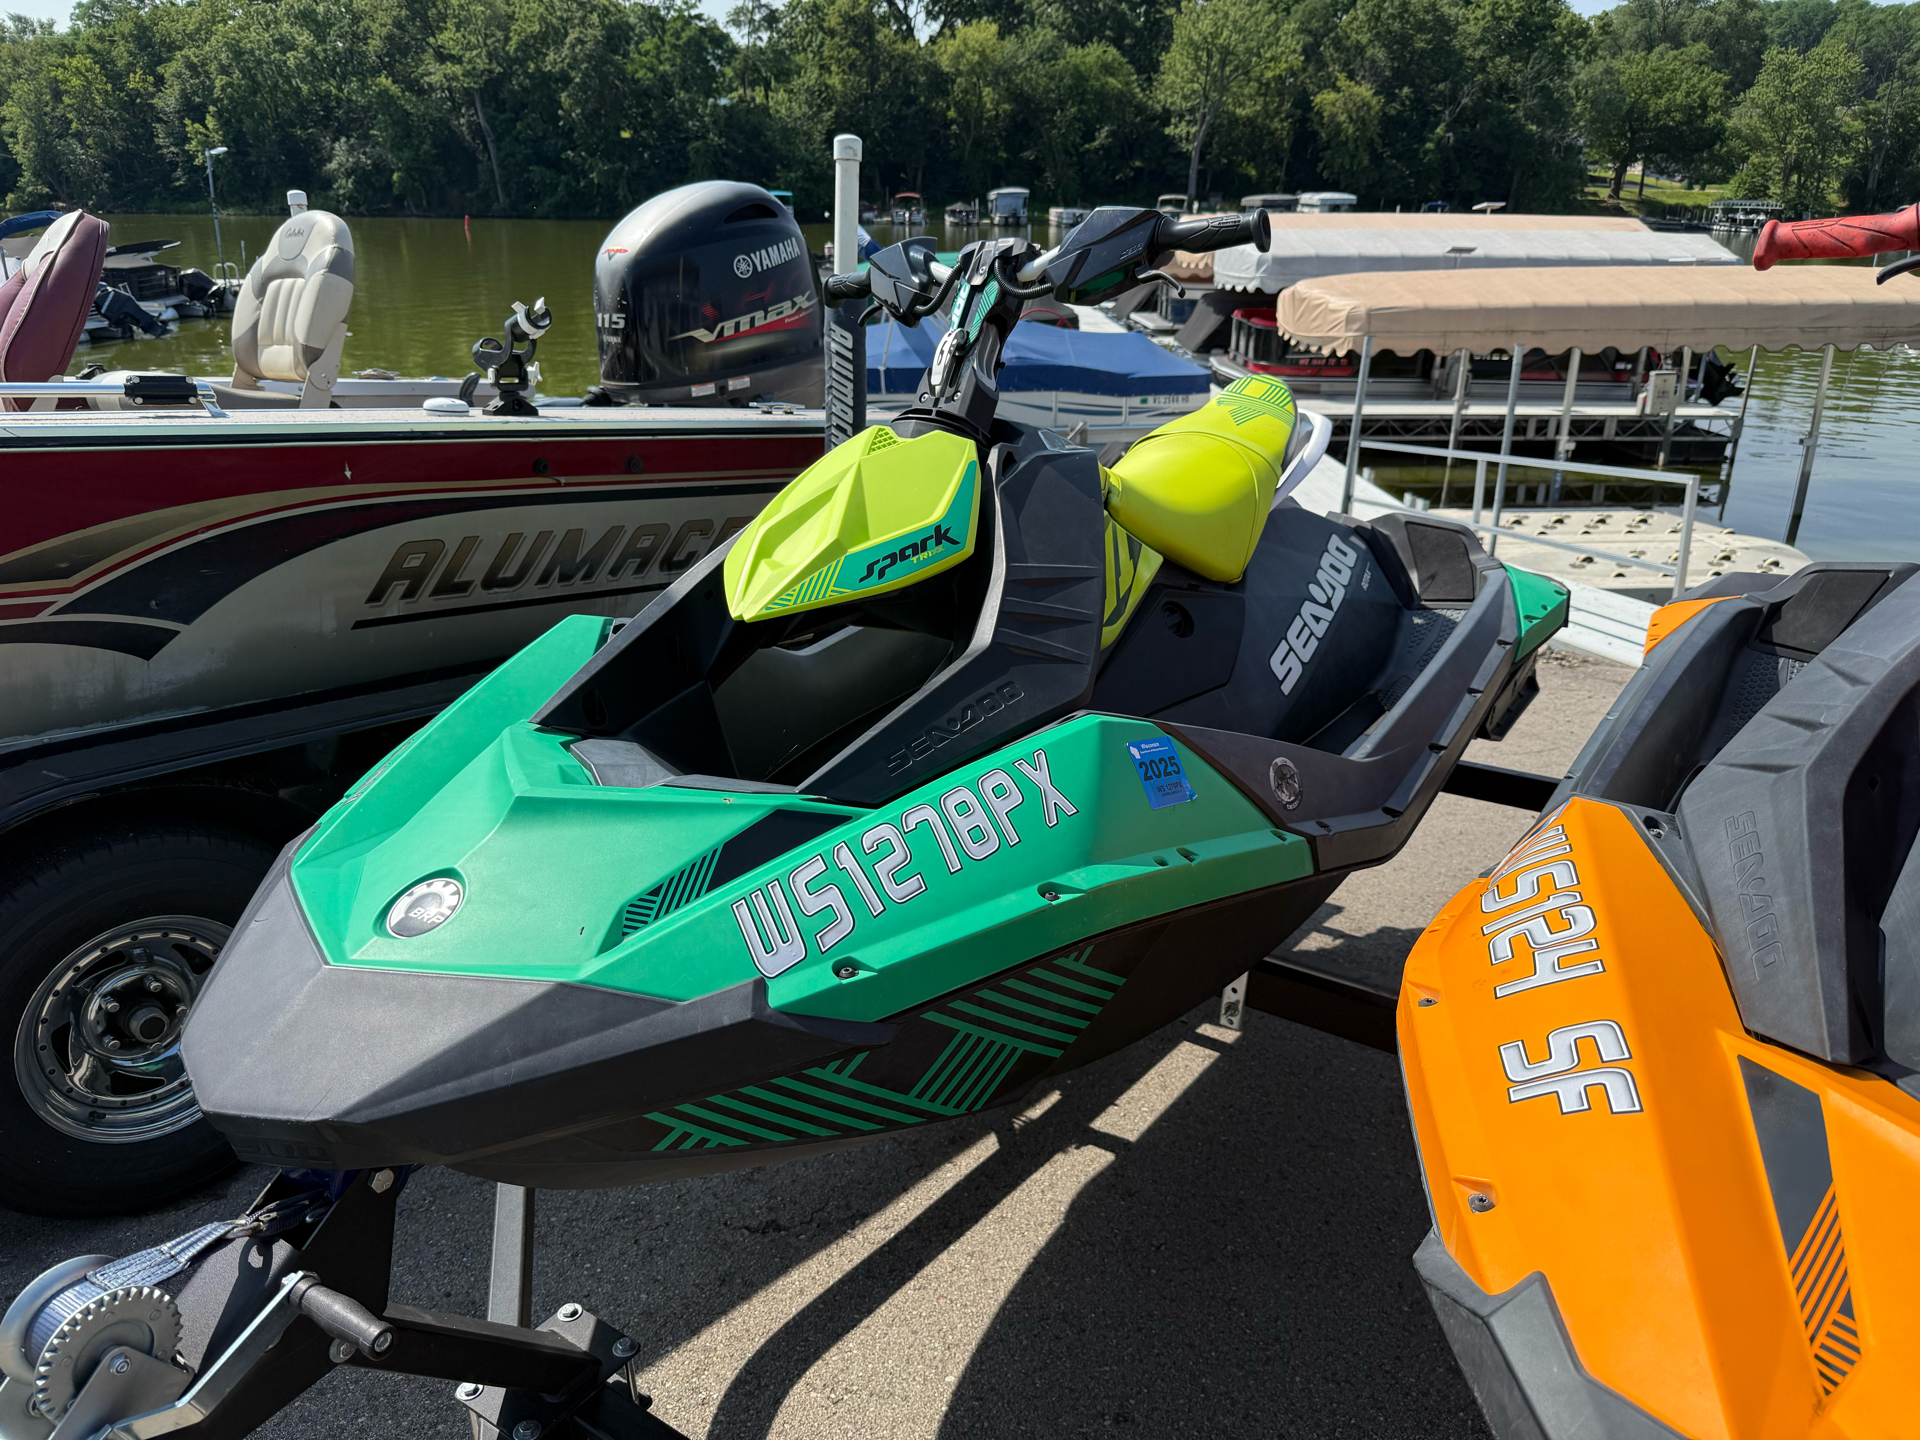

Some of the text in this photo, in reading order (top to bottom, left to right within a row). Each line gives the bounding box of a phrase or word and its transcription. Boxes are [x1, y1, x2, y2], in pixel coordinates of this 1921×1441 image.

[750, 236, 801, 273] YAMAHA
[597, 312, 626, 329] 115
[1138, 755, 1181, 782] 2025
[731, 748, 1079, 979] WS1278PX
[408, 906, 445, 924] BRP
